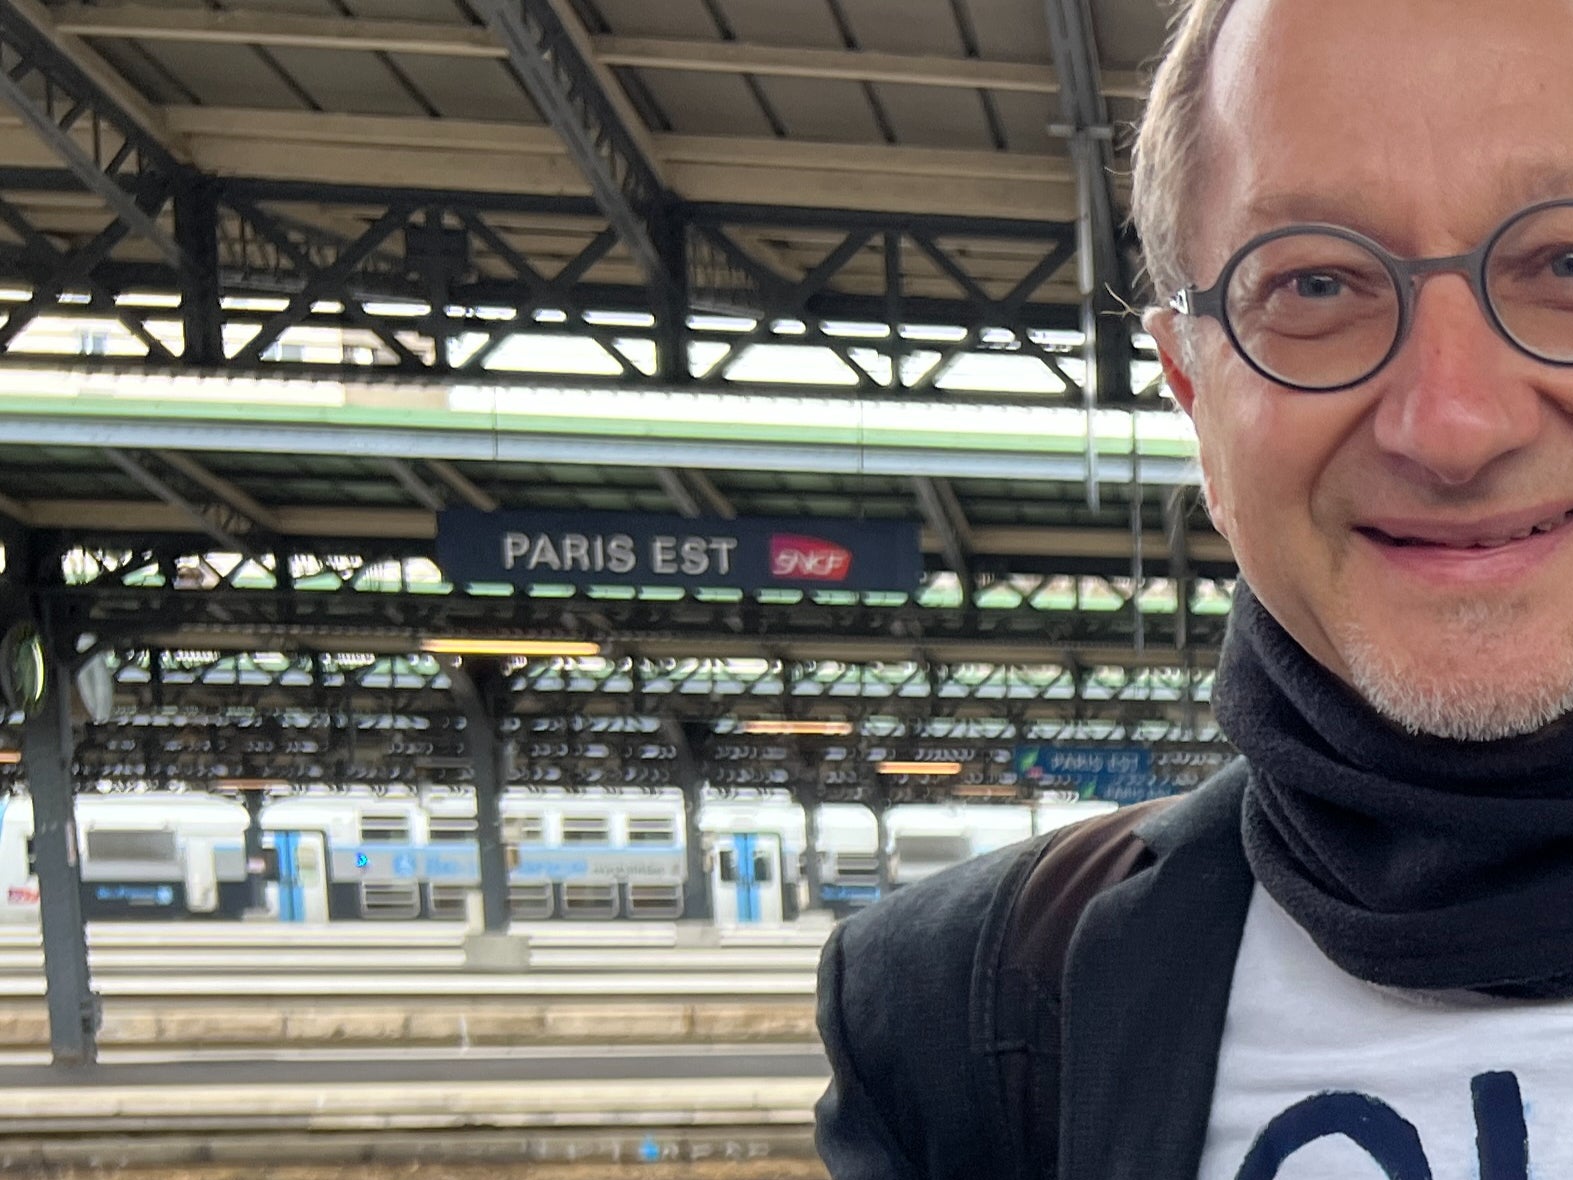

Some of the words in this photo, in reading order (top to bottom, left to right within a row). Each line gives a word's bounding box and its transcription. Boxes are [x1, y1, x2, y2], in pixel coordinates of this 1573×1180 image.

[503, 532, 637, 573] PARIS
[653, 535, 738, 575] EST
[772, 550, 845, 576] SNCF
